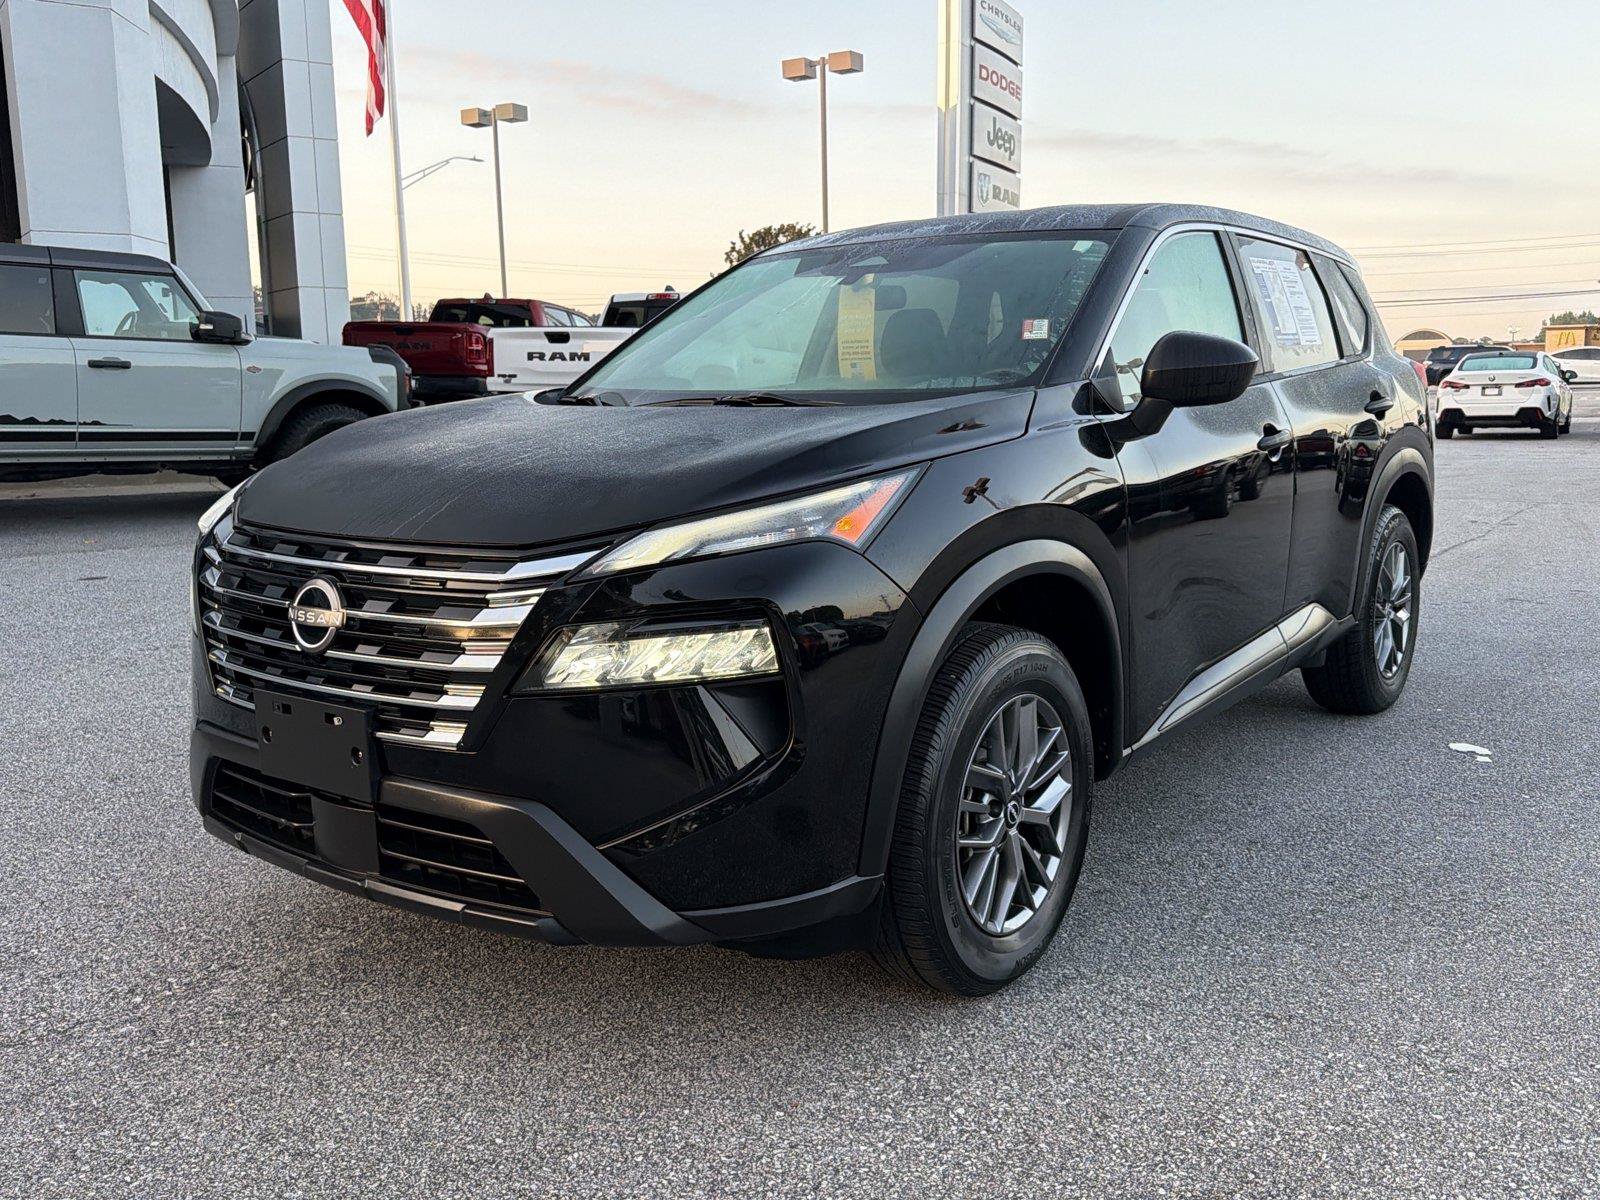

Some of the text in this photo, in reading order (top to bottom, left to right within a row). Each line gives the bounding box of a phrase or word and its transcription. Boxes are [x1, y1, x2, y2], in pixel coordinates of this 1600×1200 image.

[980, 0, 1022, 34] CHRYSLER
[978, 64, 1021, 102] DODGE
[986, 116, 1016, 162] Jeep
[992, 183, 1020, 208] RAM
[527, 352, 590, 362] RAM
[288, 607, 341, 625] NISSAN
